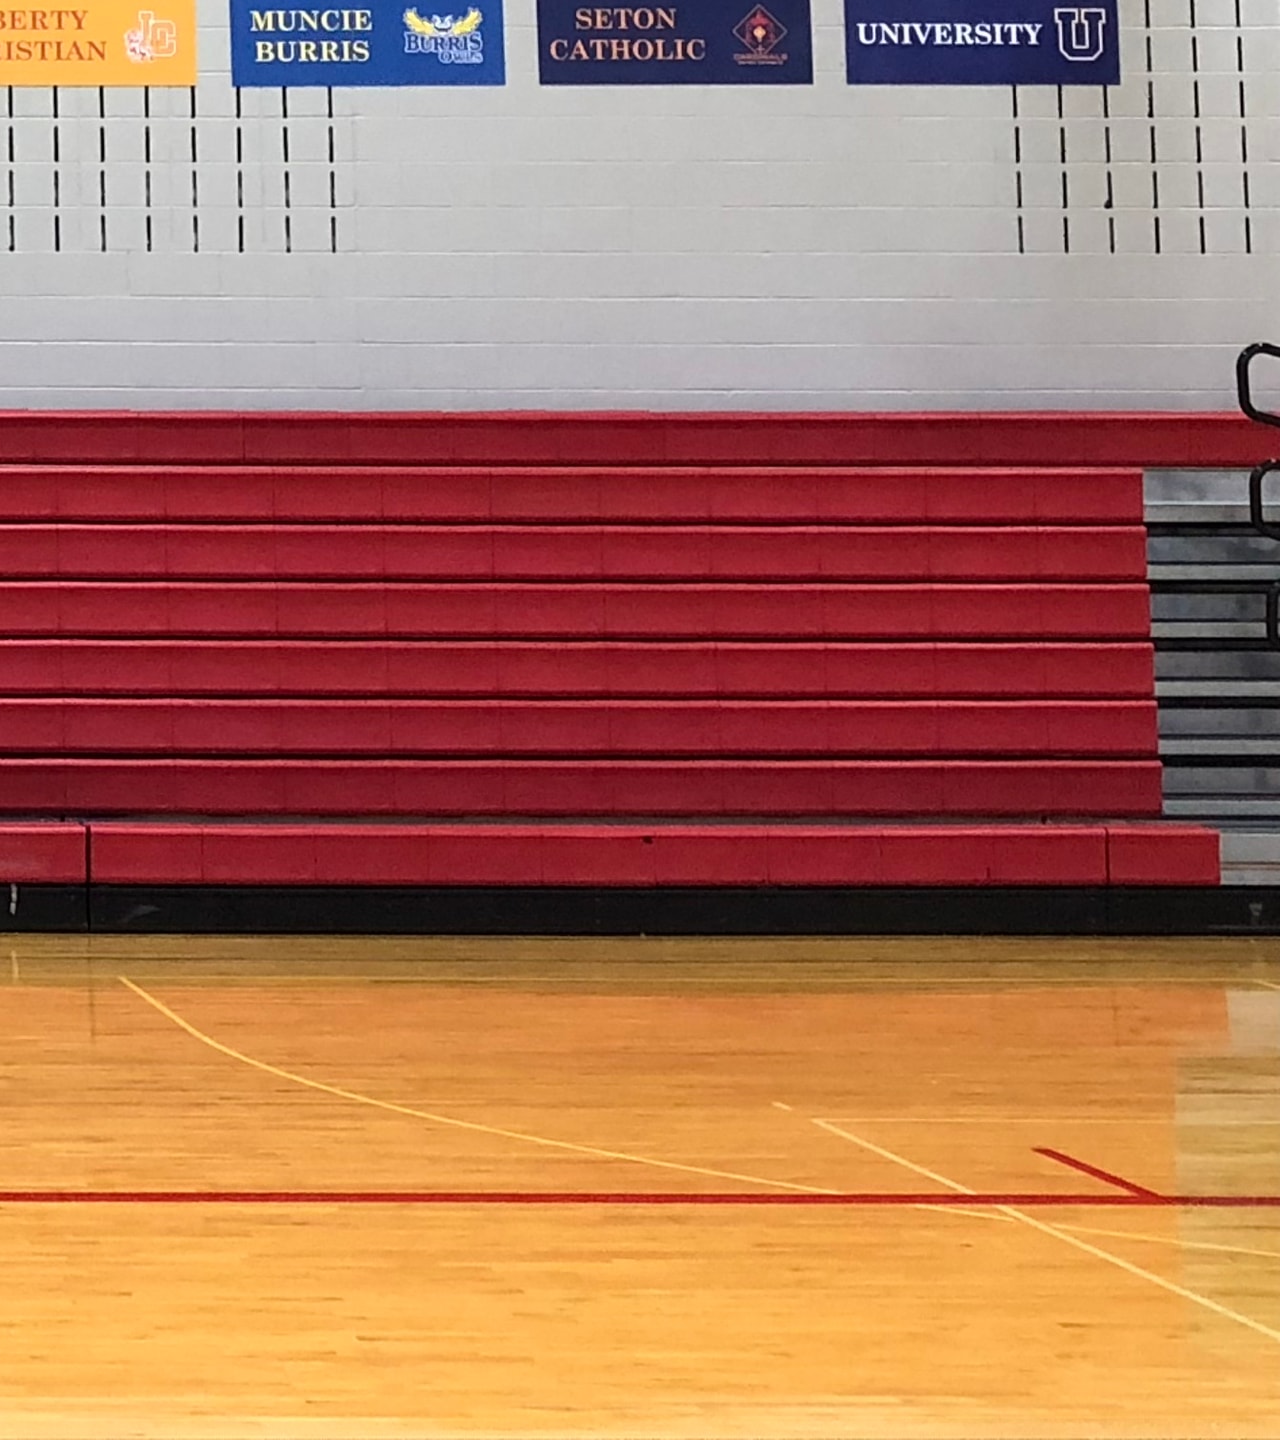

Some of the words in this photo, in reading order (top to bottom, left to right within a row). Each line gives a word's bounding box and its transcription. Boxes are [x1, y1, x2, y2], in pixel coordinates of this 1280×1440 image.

[250, 9, 373, 32] MUNCIE
[575, 8, 676, 30] SETON
[406, 33, 482, 52] BURRIS
[857, 23, 1043, 45] UNIVERSITY
[255, 40, 370, 62] BURRIS
[549, 38, 705, 61] CATHOLIC
